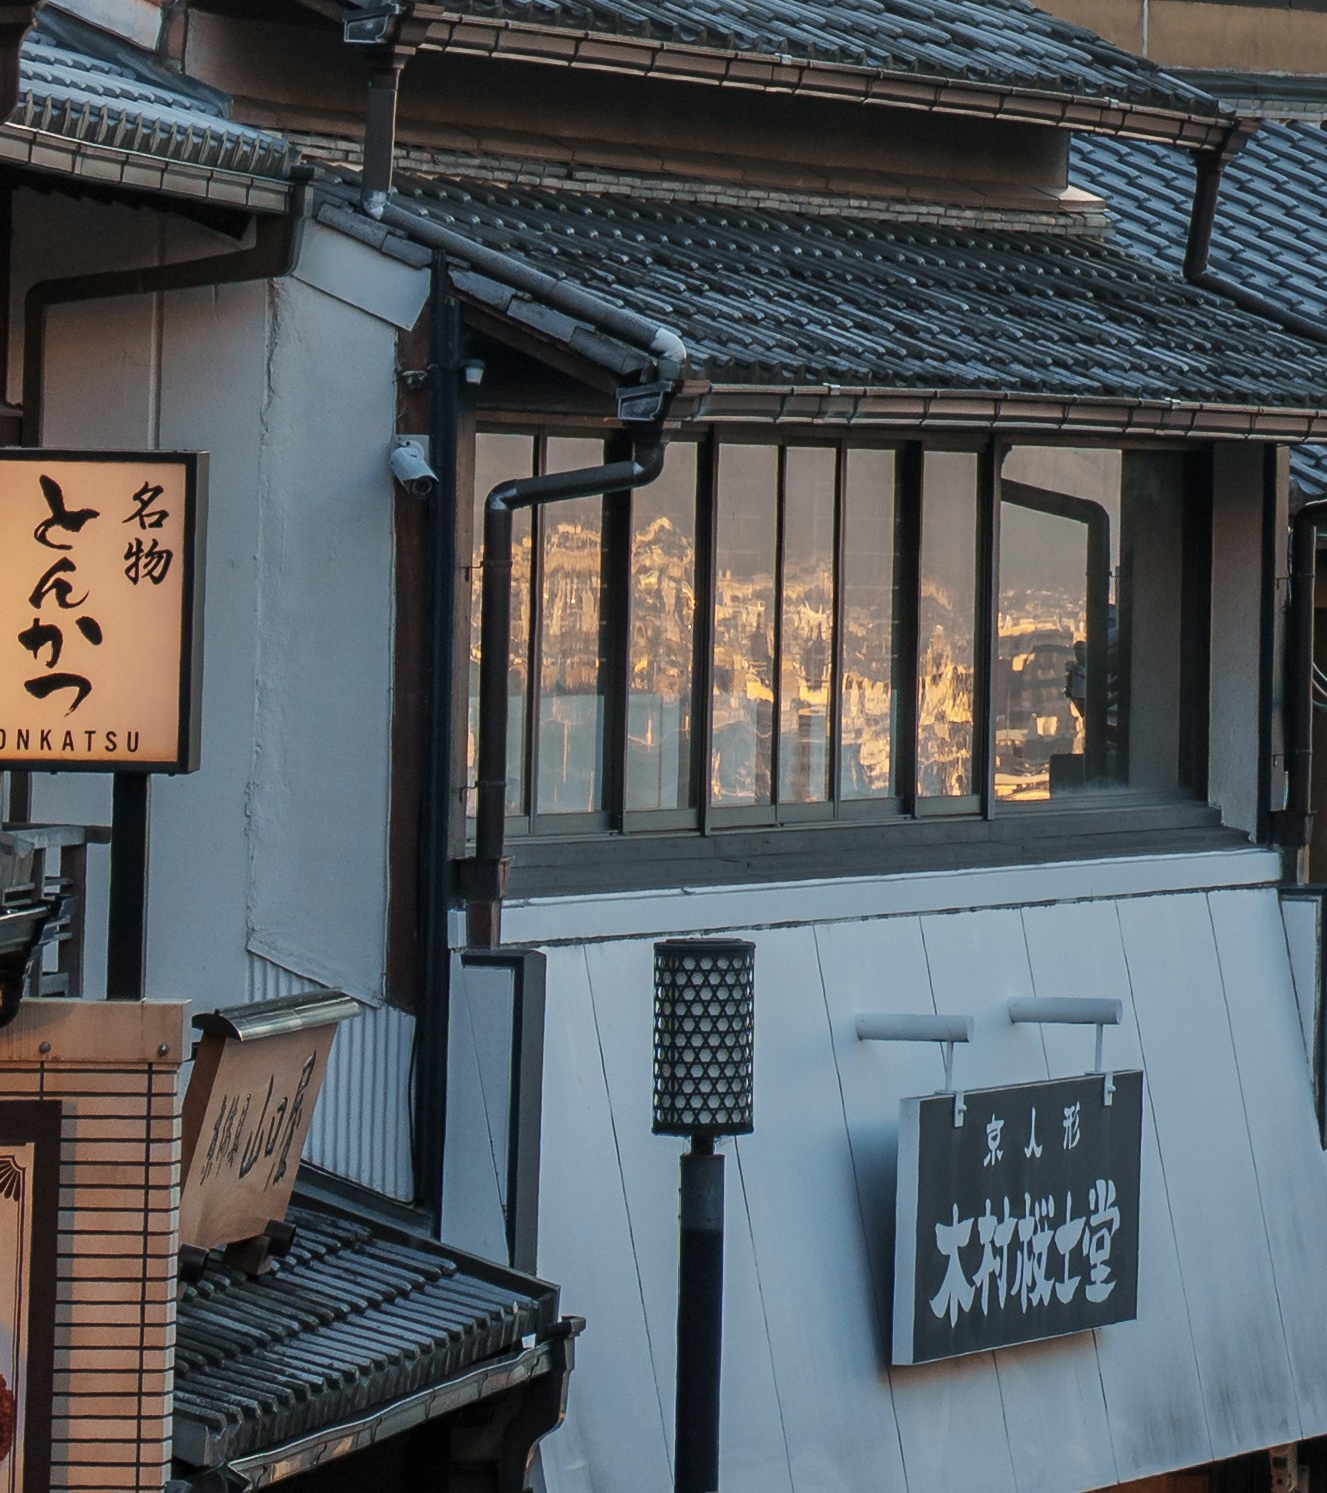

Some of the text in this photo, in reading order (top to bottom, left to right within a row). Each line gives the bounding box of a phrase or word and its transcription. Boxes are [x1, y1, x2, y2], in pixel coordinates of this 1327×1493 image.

[122, 481, 174, 586] 名物
[17, 474, 103, 716] とんかつ
[982, 1105, 1081, 1168] 京人形
